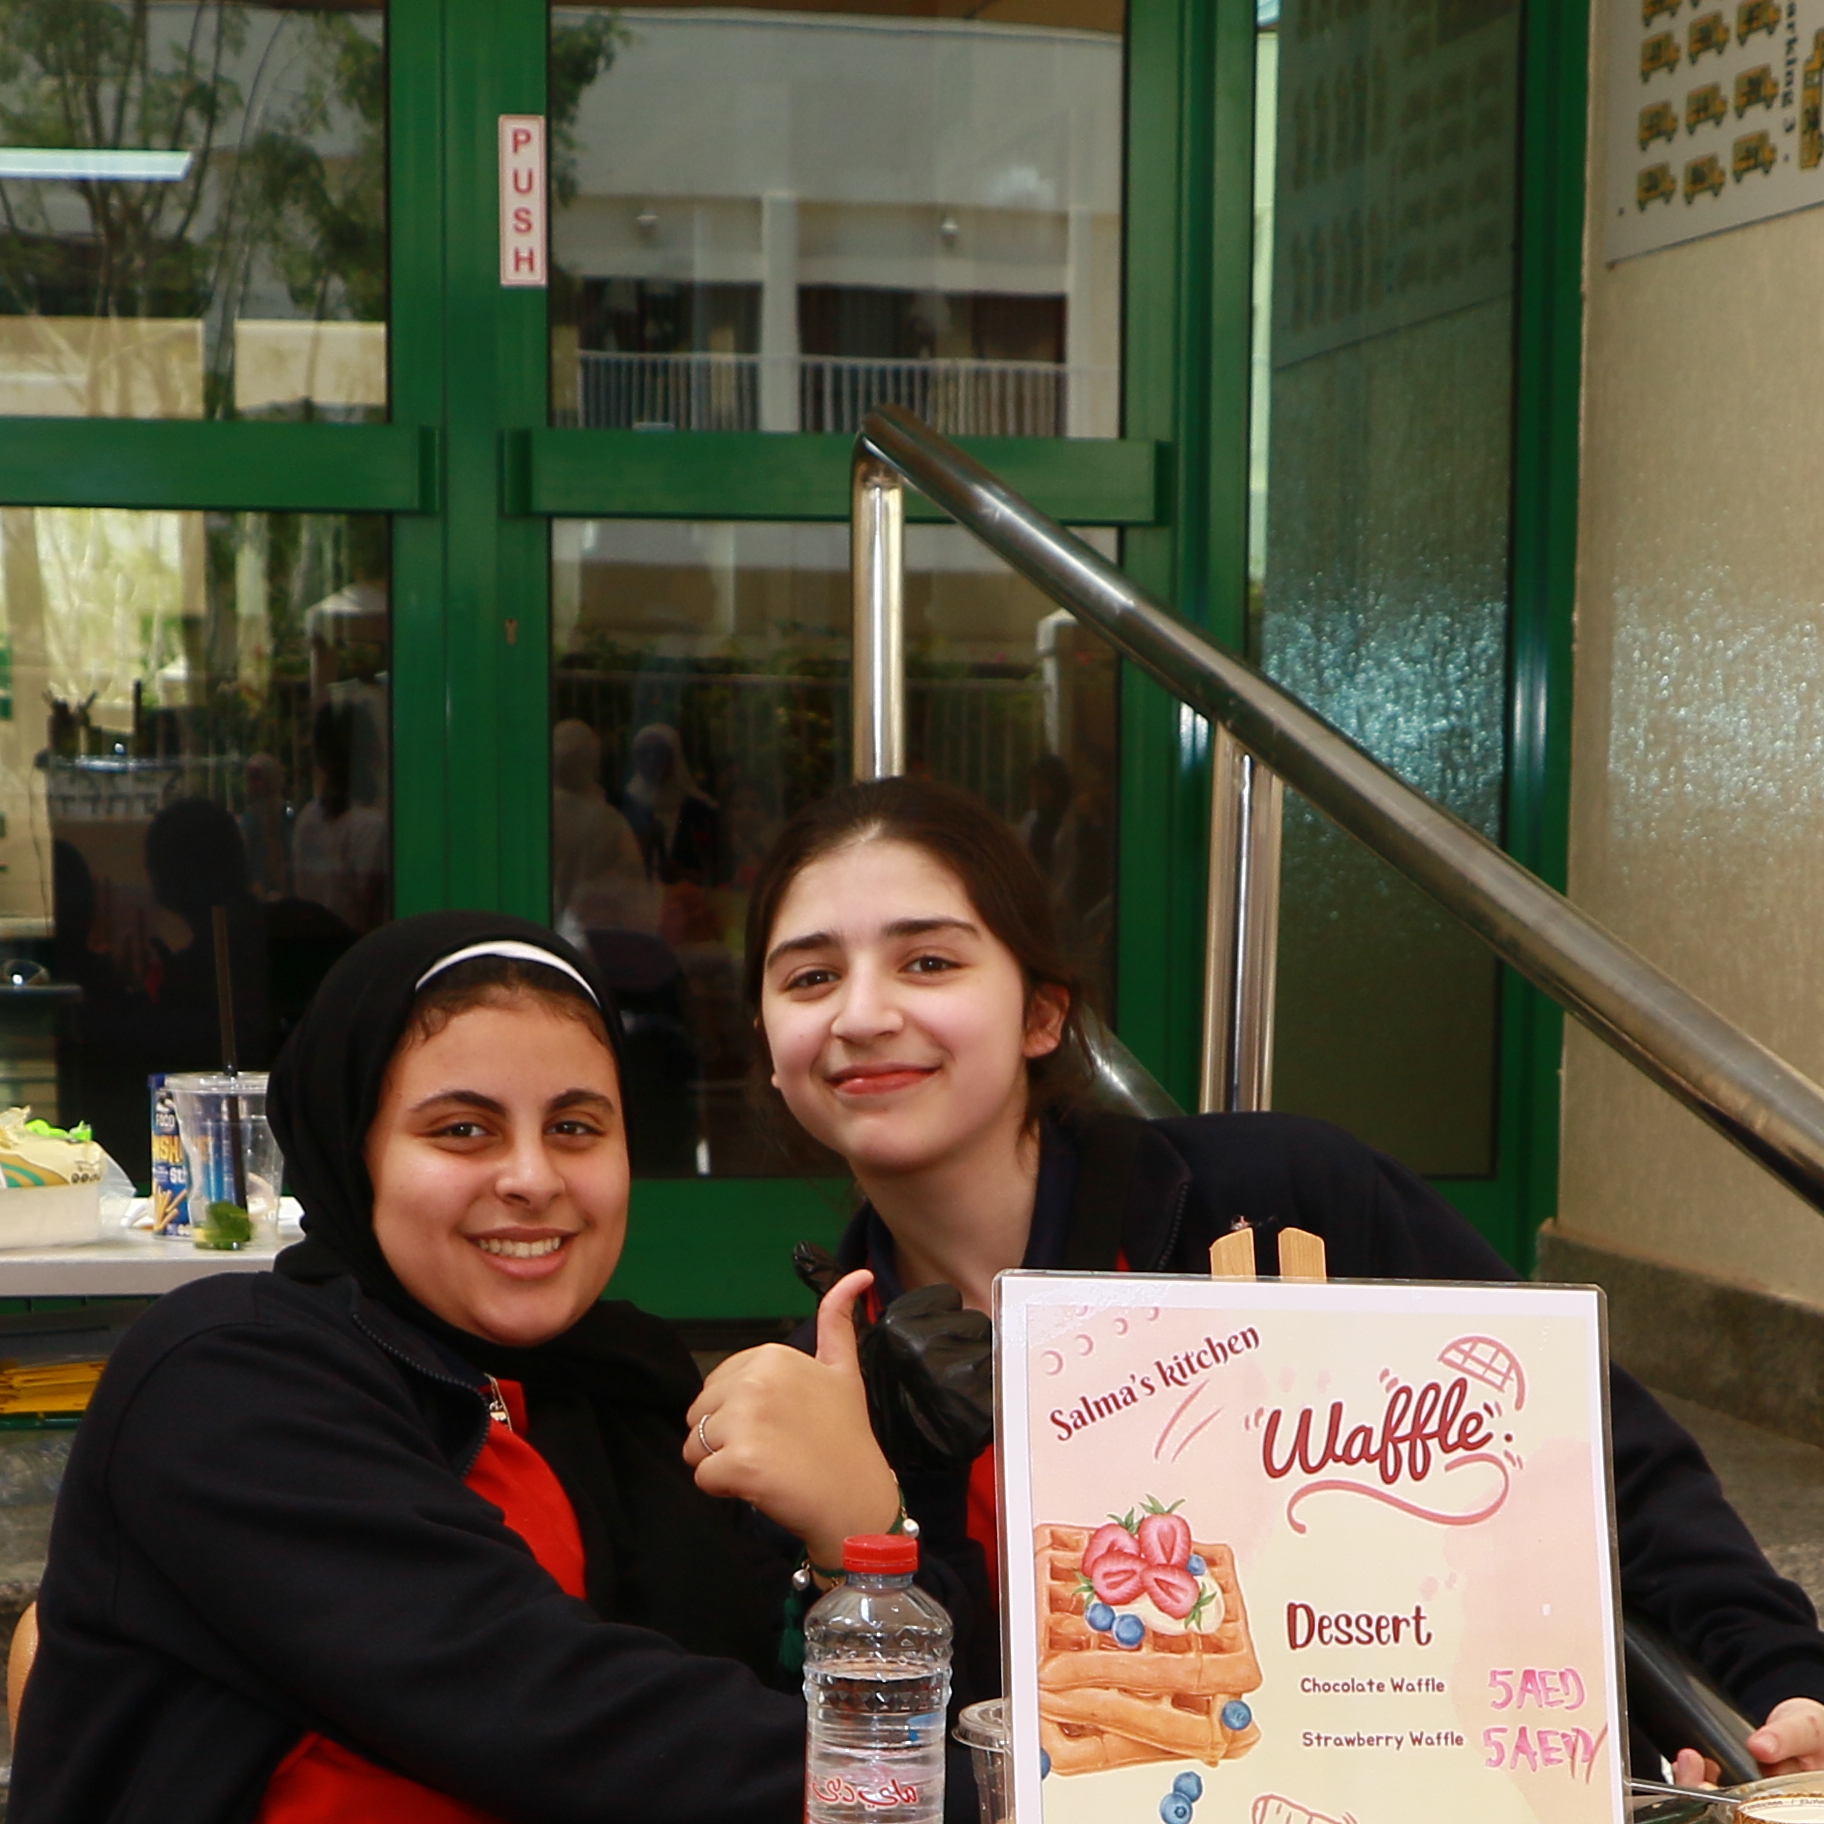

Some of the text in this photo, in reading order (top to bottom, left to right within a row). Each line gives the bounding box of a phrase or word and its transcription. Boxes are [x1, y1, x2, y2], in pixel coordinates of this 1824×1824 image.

[511, 127, 535, 274] PUSH
[1049, 1327, 1260, 1441] Salma's kitchen
[1262, 1377, 1494, 1485] Waffle
[1287, 1603, 1433, 1651] Dessert
[1300, 1677, 1445, 1693] Chocolate Waffle
[1302, 1731, 1464, 1751] Strawberry Waffle
